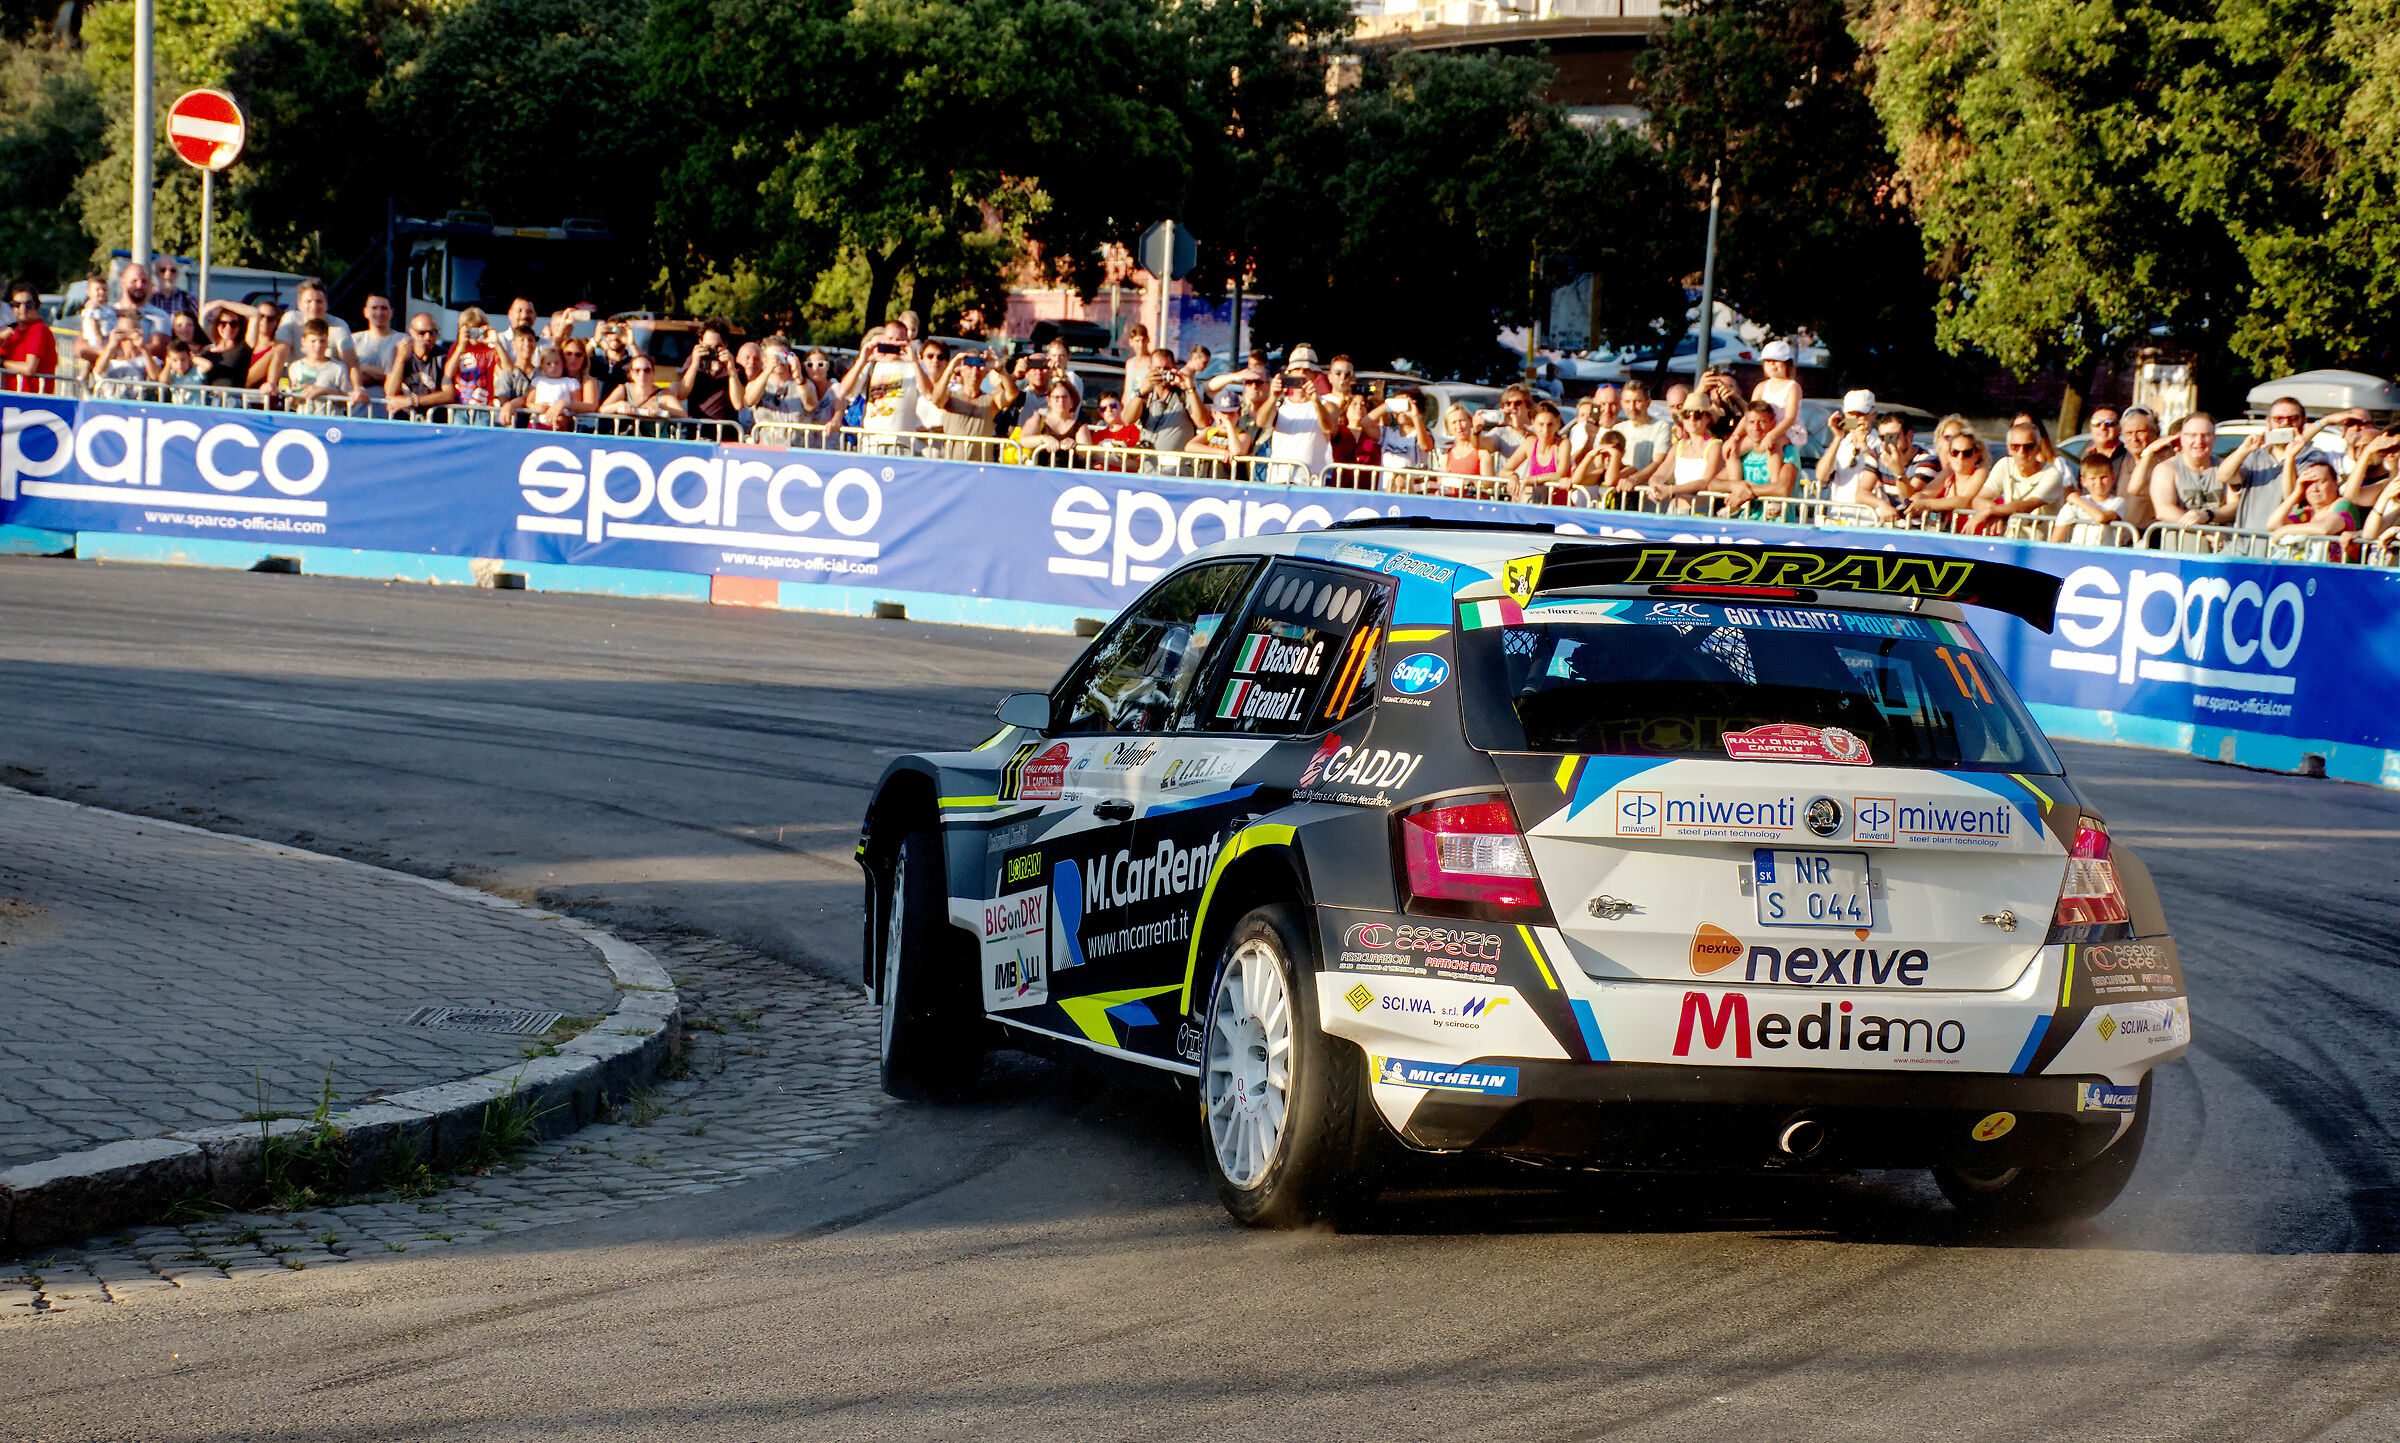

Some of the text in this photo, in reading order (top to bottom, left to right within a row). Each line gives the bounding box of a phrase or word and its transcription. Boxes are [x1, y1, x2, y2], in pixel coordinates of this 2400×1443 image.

[519, 446, 883, 543] sparco
[144, 511, 327, 535] www.sparco-official.com
[1052, 486, 1381, 586] spar
[721, 552, 879, 575] www.sparco-official.com
[1622, 549, 1975, 597] LORAN
[1528, 608, 1598, 616] www.fiaerc.com
[1724, 607, 1927, 638] GOT TALENT? PROVE IT!
[2057, 565, 2305, 684] sparco
[1261, 638, 1325, 676] Basso G.
[1324, 626, 1381, 720] 11
[1394, 662, 1445, 686] Sang-A
[1934, 646, 1993, 704] 11
[1243, 683, 1306, 722] Granai L.
[1728, 737, 1766, 745] RALLY
[1783, 739, 1818, 747] ROMA
[1003, 745, 1038, 799] 11
[1323, 745, 1423, 790] GADDI
[1666, 793, 1794, 826] miwenti
[1899, 801, 2010, 834] miwenti
[1622, 824, 1656, 834] miwenti
[1677, 828, 1781, 840] steel plant technology
[1859, 831, 1890, 840] miwenti
[1908, 835, 1999, 847] steel plant technology
[1008, 852, 1041, 883] LORAN
[1086, 831, 1220, 914] M.CarRent
[1759, 856, 1831, 885] SK NR
[985, 894, 1042, 936] BIGonDRY
[1768, 893, 1863, 920] S 044
[1087, 908, 1189, 958] www.mcarrent.it
[1396, 924, 1502, 948] AGENZIA
[1697, 942, 1741, 955] nexive
[1340, 952, 1411, 965] ASSICURAZIONI
[1394, 937, 1501, 961] CAPELLI
[1745, 932, 1929, 986] nexive
[994, 952, 1040, 992] IMBALLI
[1425, 957, 1469, 971] PRATICHE
[1469, 961, 1498, 975] AUTO
[1382, 995, 1459, 1016] SCI.WA. s.r.l.
[1433, 1019, 1480, 1029] by scirocco
[1672, 991, 1966, 1059] Mediamo
[1408, 1069, 1506, 1087] MICHELIN
